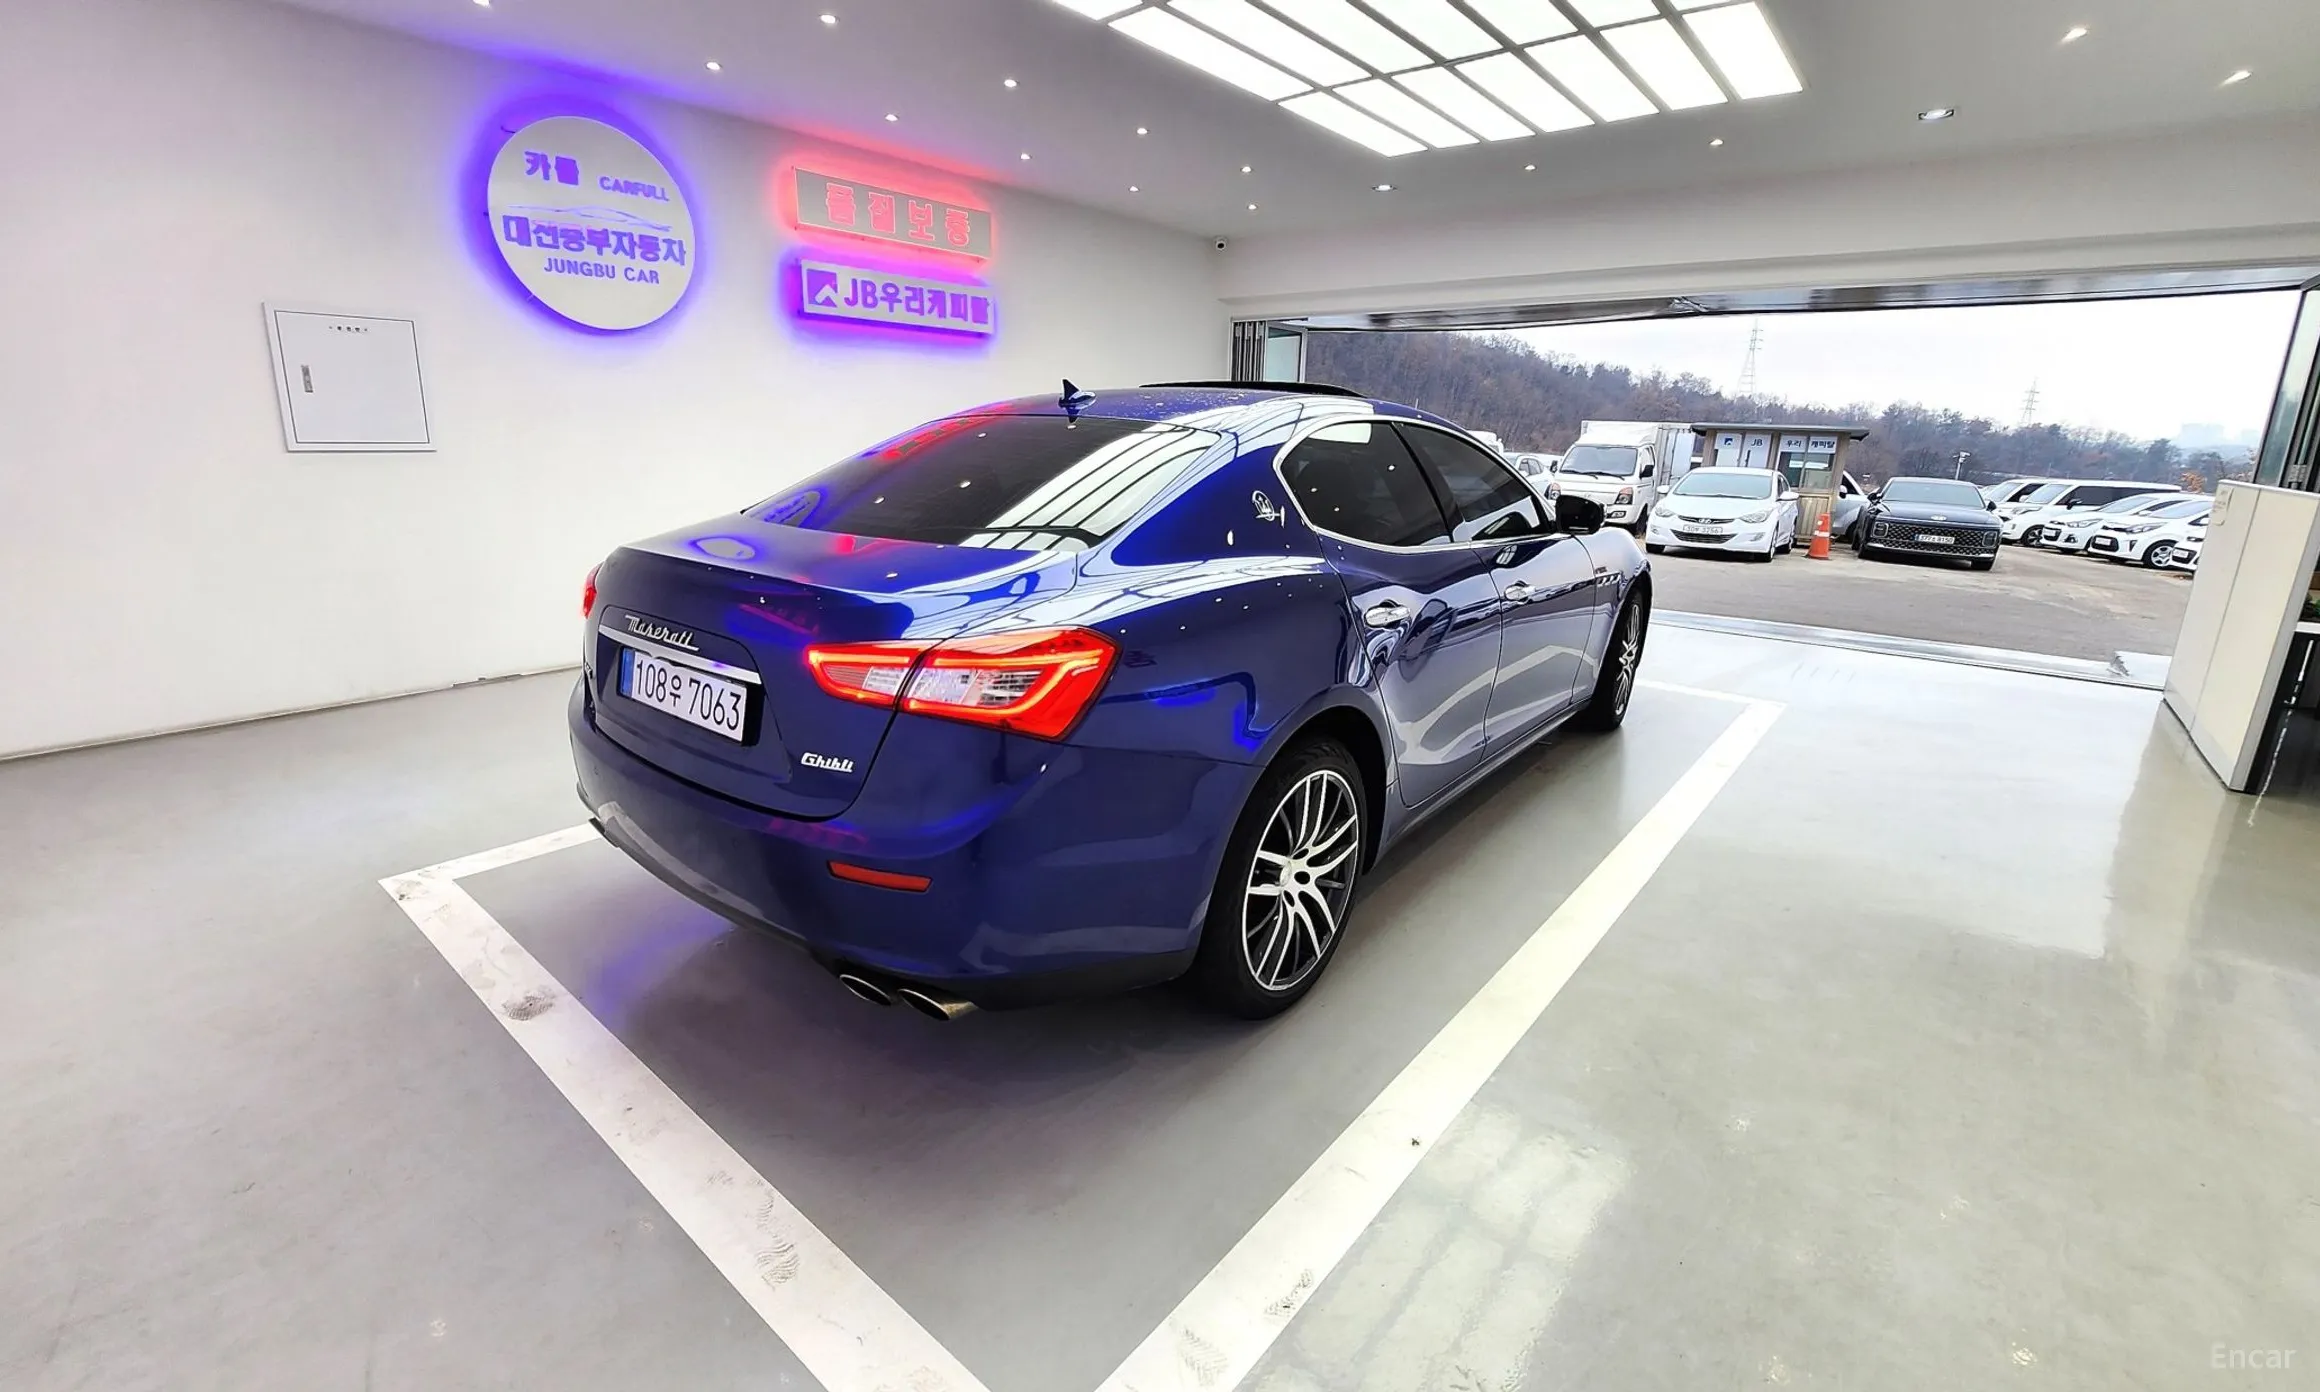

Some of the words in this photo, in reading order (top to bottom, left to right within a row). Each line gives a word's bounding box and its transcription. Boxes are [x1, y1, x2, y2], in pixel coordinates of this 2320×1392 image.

[599, 176, 669, 202] CARFULL
[544, 257, 616, 279] JUNGBU
[624, 267, 660, 285] CAR
[1751, 438, 1763, 447] JB
[625, 614, 700, 652] Maserati
[636, 659, 682, 707] 108우
[688, 678, 743, 731] 7063
[801, 752, 854, 773] Ghibli
